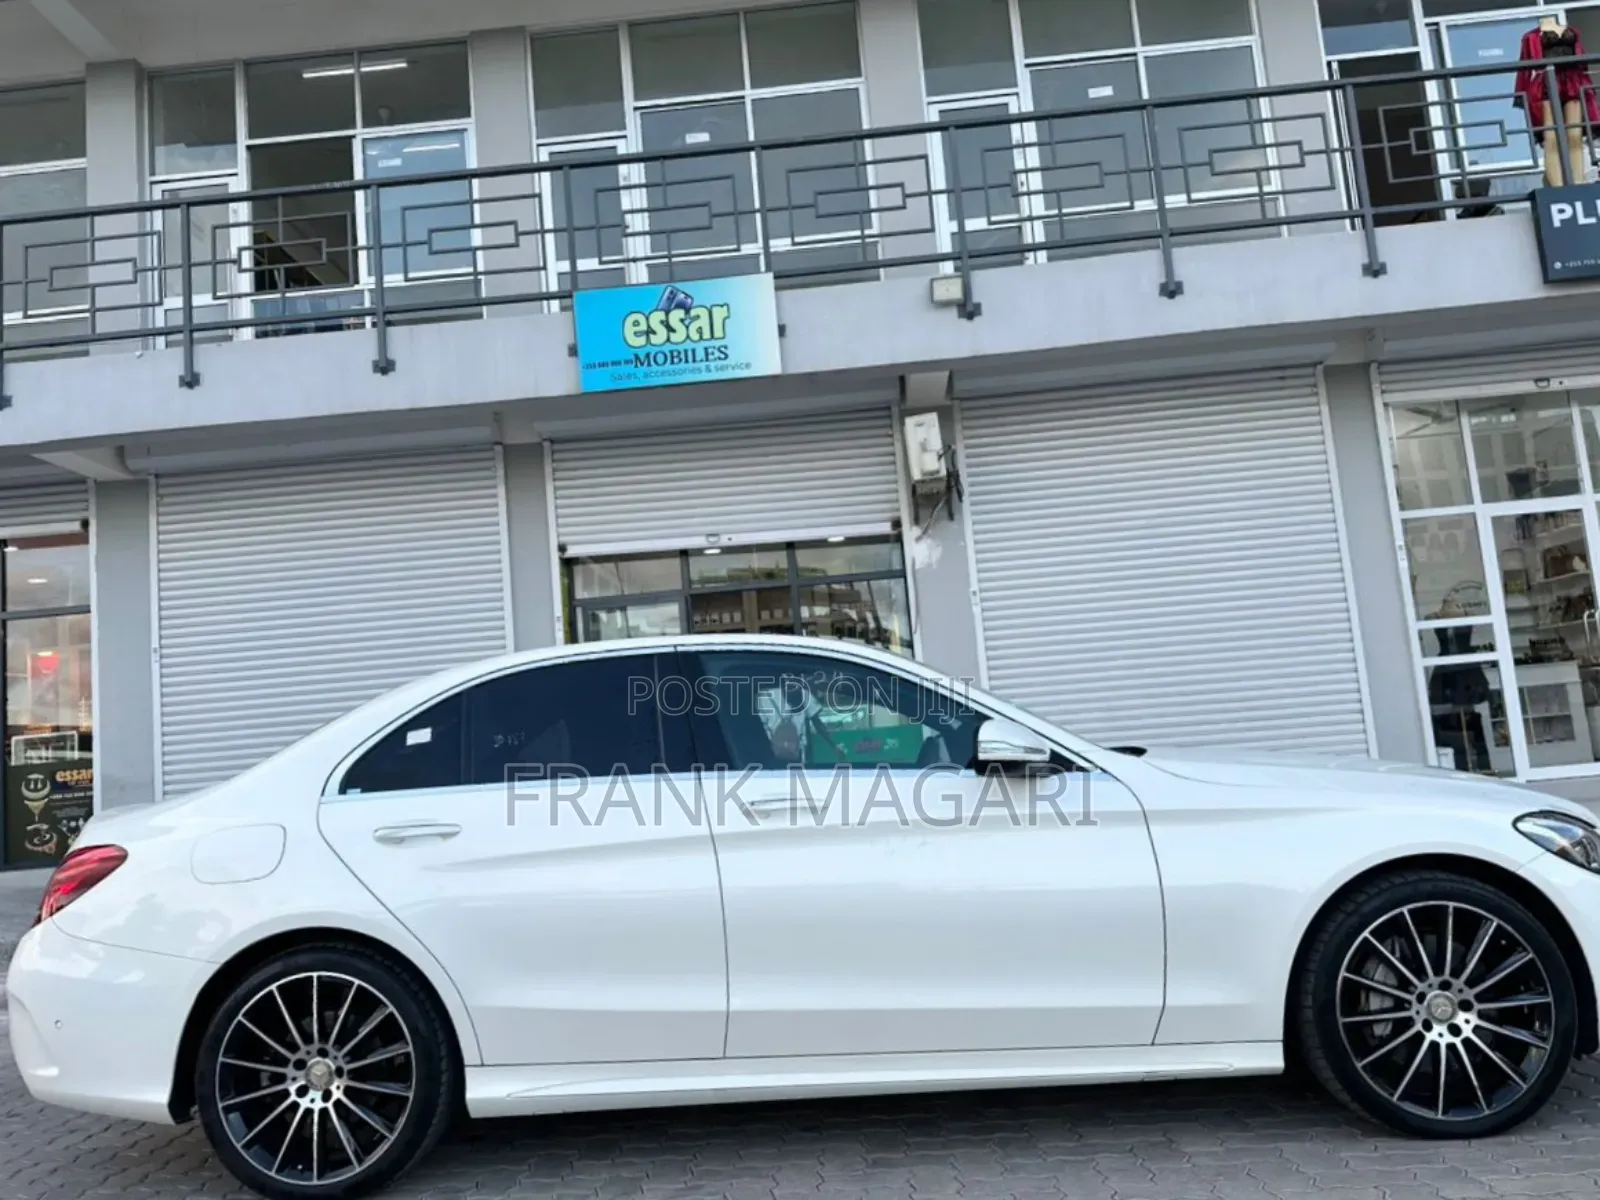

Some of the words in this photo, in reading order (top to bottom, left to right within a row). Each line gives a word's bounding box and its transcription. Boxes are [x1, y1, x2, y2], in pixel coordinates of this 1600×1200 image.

[1550, 199, 1600, 228] PL
[622, 303, 730, 348] essar
[633, 345, 729, 368] MOBILES
[642, 366, 703, 379] accessories
[704, 364, 712, 373] &
[714, 361, 752, 371] service
